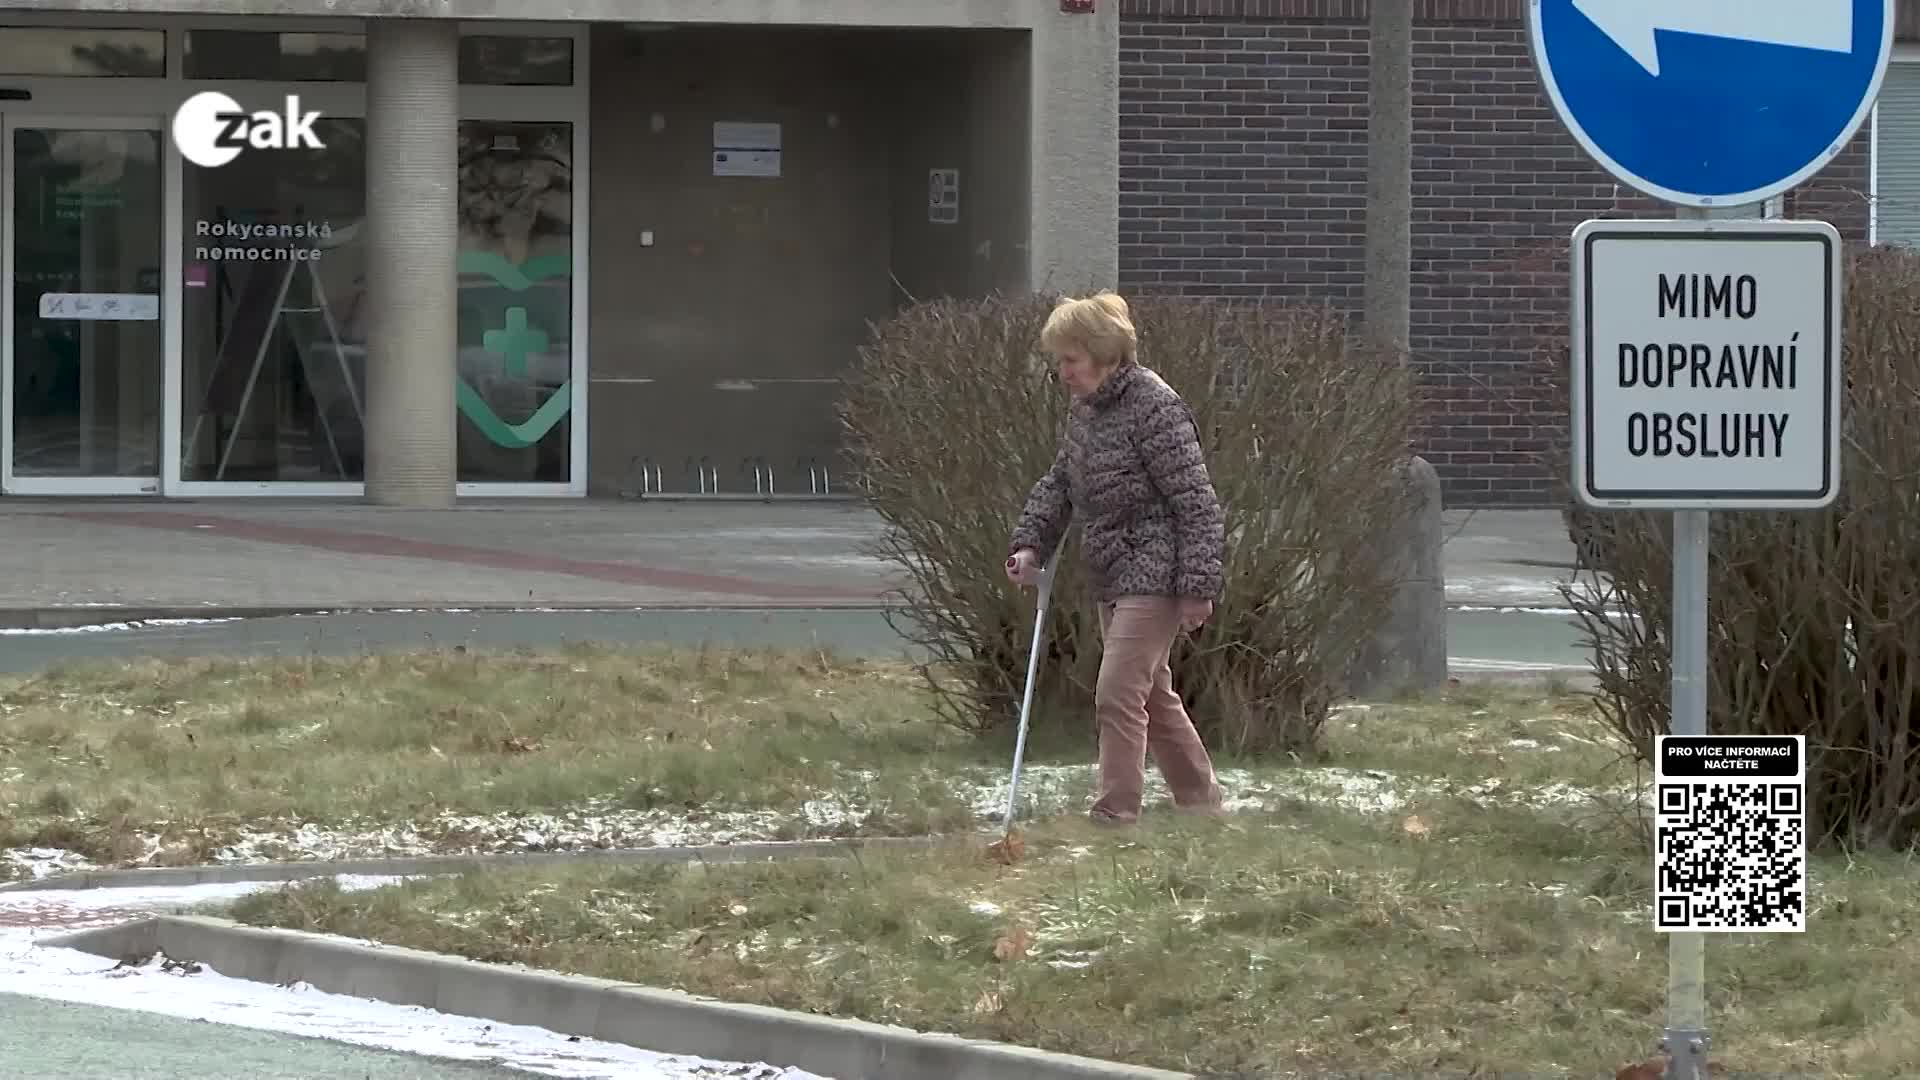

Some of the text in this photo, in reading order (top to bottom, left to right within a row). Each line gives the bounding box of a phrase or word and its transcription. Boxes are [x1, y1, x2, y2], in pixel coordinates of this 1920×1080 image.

[195, 243, 321, 260] nemocnice
[196, 219, 332, 240] Rokycanská
[1658, 273, 1757, 319] MIMO
[1618, 331, 1799, 389] DOPRAVNÍ
[1627, 412, 1789, 457] OBSLUHY
